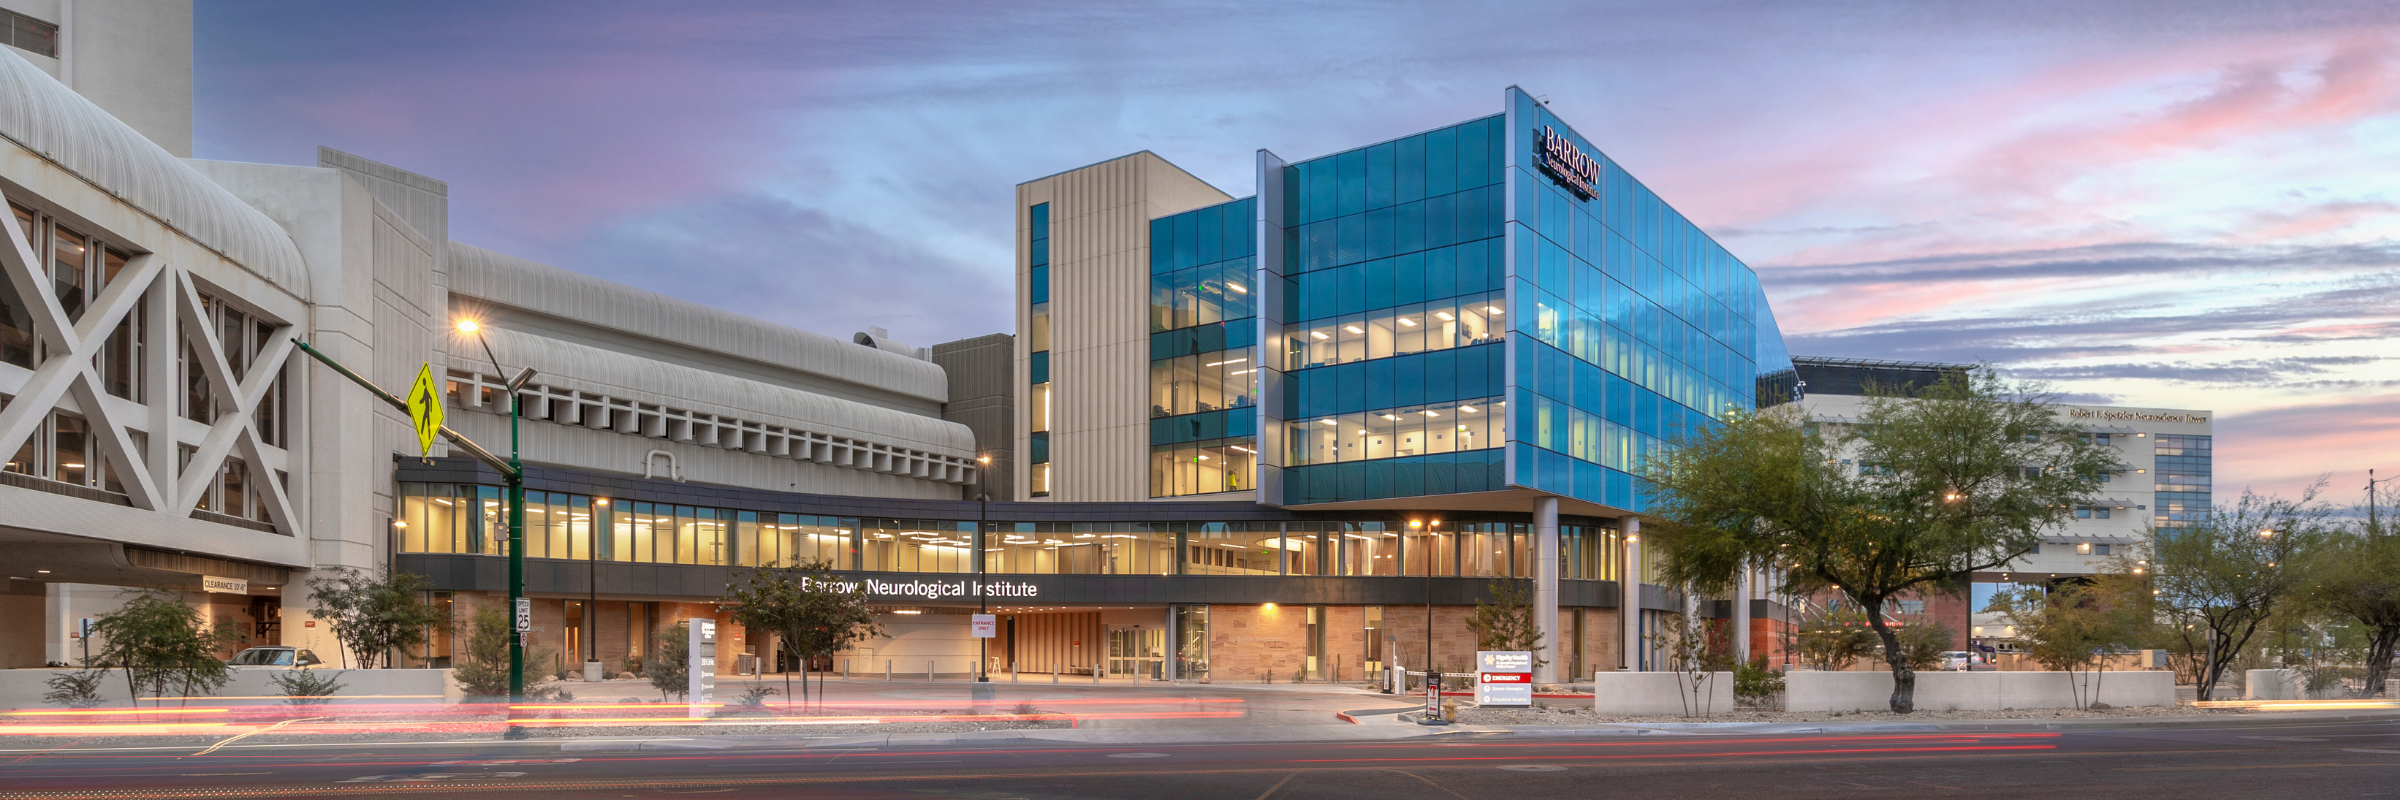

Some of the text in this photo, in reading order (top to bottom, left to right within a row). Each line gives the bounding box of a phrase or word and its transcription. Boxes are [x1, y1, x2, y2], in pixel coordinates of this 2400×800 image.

[1545, 125, 1601, 185] BARROW
[1546, 152, 1600, 200] Neurological Institute
[2069, 409, 2094, 419] Robert
[2103, 410, 2133, 421] Spetzler
[2134, 411, 2182, 422] Neuroscience
[2184, 413, 2207, 423] Tower
[205, 580, 233, 590] CLEARANCE
[866, 578, 965, 599] Neurological
[518, 614, 529, 629] 25
